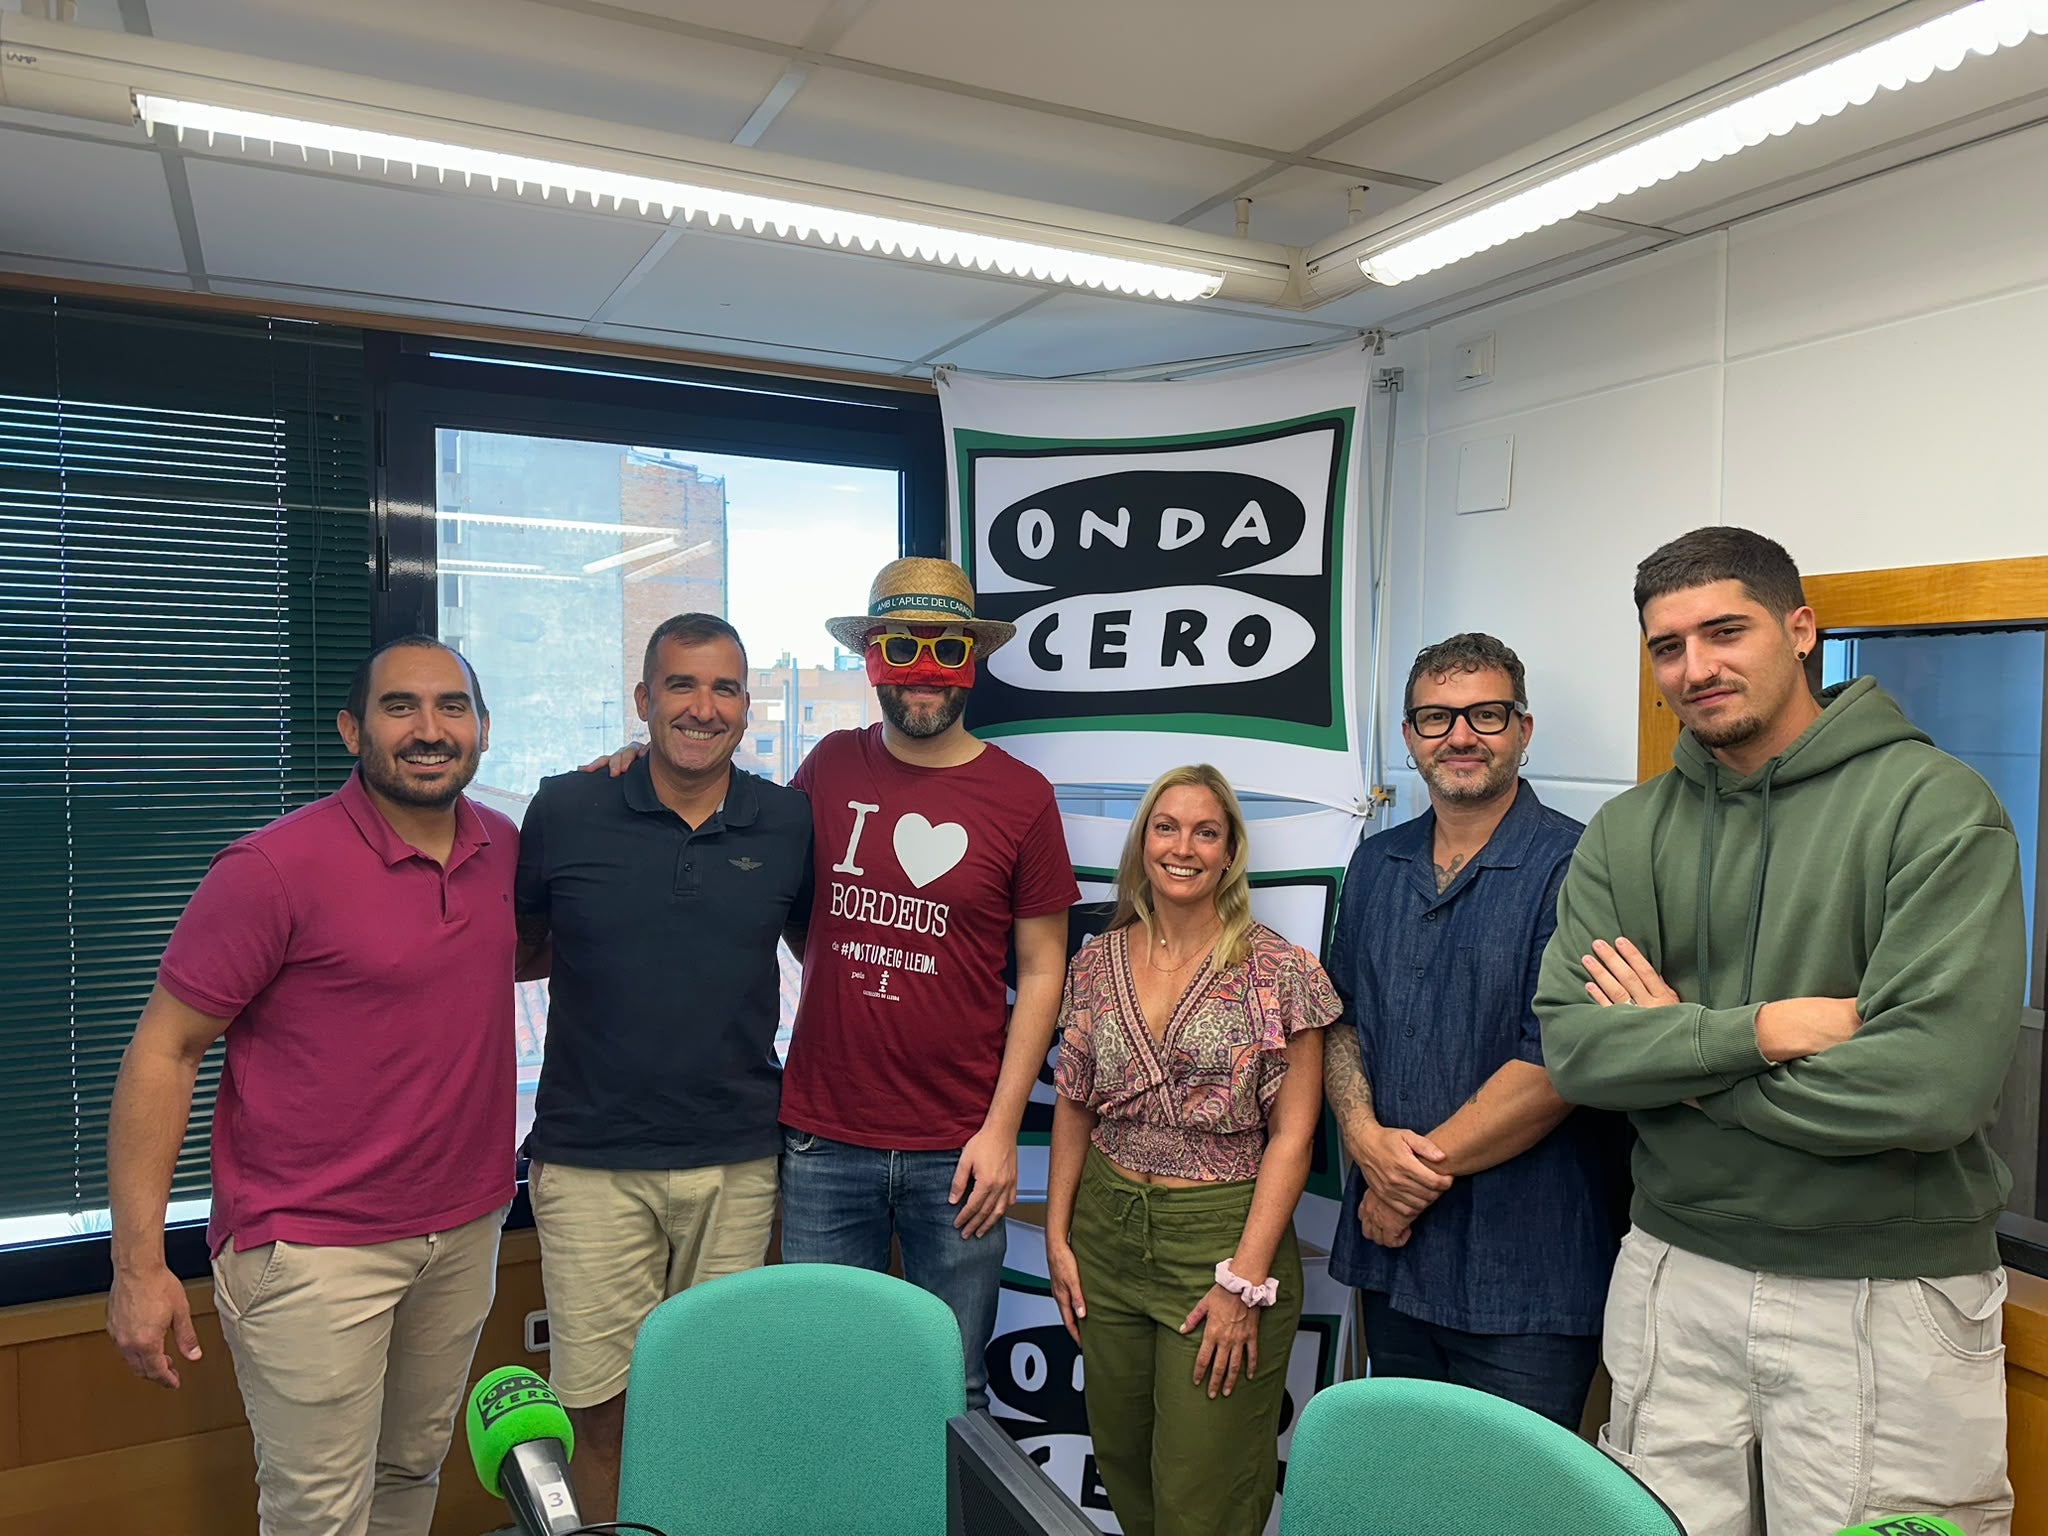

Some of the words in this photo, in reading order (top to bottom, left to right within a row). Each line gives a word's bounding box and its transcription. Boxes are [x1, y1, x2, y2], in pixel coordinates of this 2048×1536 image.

[1016, 500, 1271, 560] ONDA
[876, 599, 891, 613] AMB
[931, 597, 949, 608] DEL
[1028, 609, 1272, 672] CERO
[832, 800, 880, 876] I
[830, 882, 950, 938] BORDEUS
[840, 941, 903, 969] #POSTUREIG
[904, 951, 939, 976] LLEIDA.
[494, 1390, 551, 1411] CERO
[547, 1491, 564, 1508] 3
